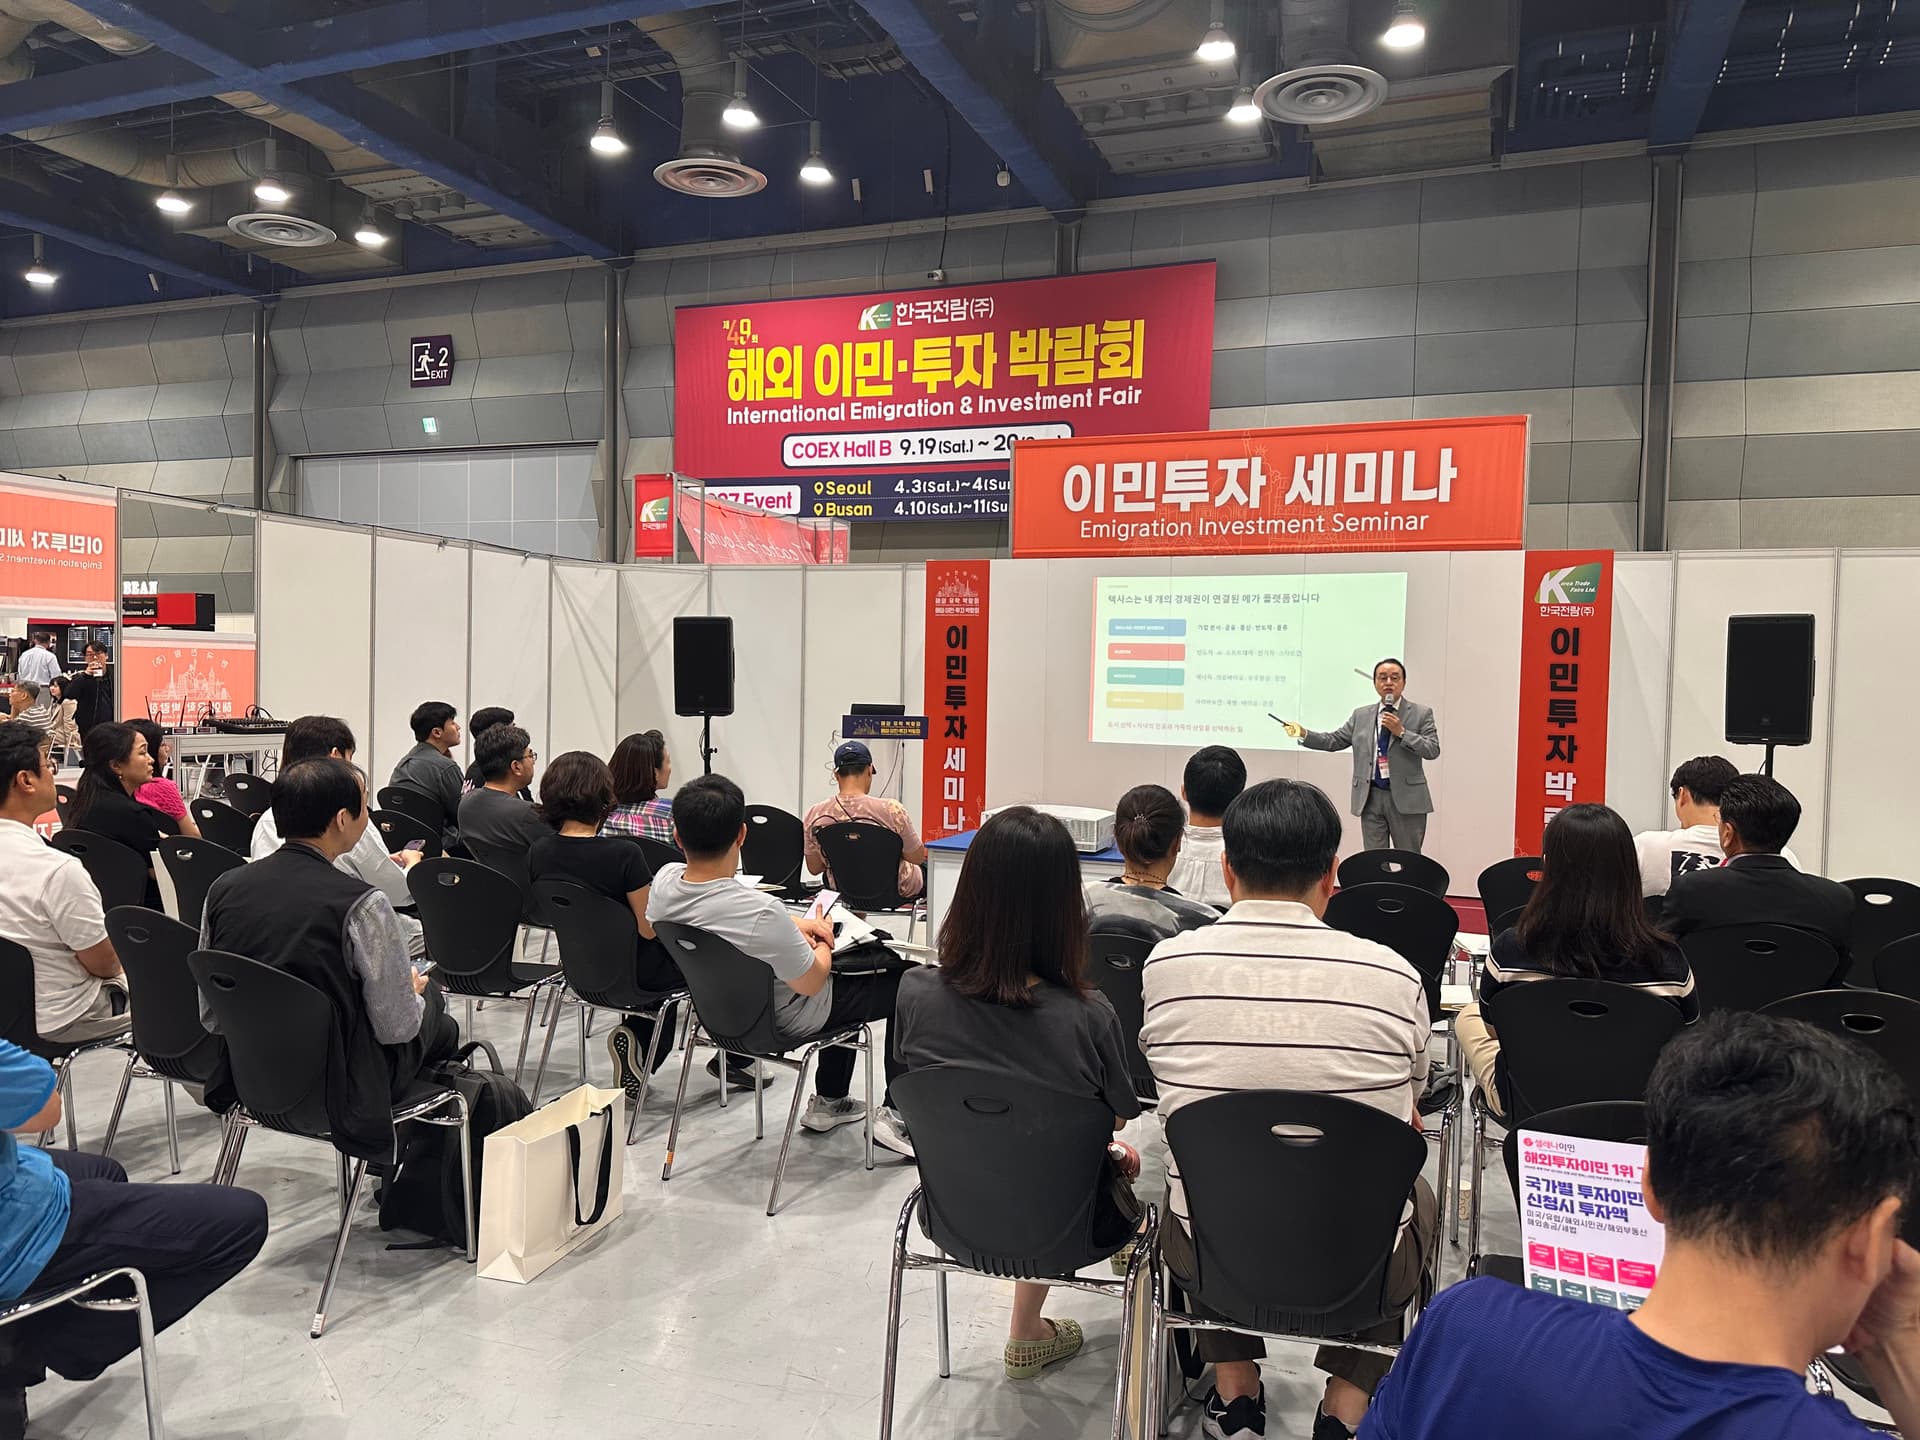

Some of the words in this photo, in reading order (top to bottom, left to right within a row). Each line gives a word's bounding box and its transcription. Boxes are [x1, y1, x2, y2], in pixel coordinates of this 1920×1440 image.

[896, 296, 994, 326] 한국전람(주)
[438, 347, 449, 367] 2
[727, 345, 803, 402] 해외
[814, 332, 998, 398] 이민·투자
[1009, 319, 1145, 387] 박람회
[431, 369, 449, 380] EXIT
[727, 403, 845, 425] International
[850, 399, 955, 422] Emigration
[960, 395, 974, 415] &
[978, 389, 1093, 414] Investment
[1098, 385, 1143, 407] Fair
[792, 441, 840, 459] COEX
[843, 440, 876, 458] Hall
[879, 439, 892, 457] B
[826, 480, 872, 496] Seoul
[1063, 456, 1267, 513] 이민투자
[1284, 448, 1458, 506] 세미나
[826, 502, 873, 517] Busan
[1080, 518, 1192, 541] Emigration
[1199, 514, 1325, 536] Investment
[1332, 511, 1430, 533] Seminar
[123, 581, 158, 594] BEAN
[1540, 605, 1595, 617] 한국전람(주)
[1524, 1150, 1609, 1175] 해외투자이민
[1611, 1164, 1634, 1178] 1위
[1525, 1175, 1574, 1197] 국가별
[1577, 1183, 1644, 1207] 투자이민
[1527, 1192, 1575, 1214] 신청시
[1578, 1201, 1629, 1223] 투자액
